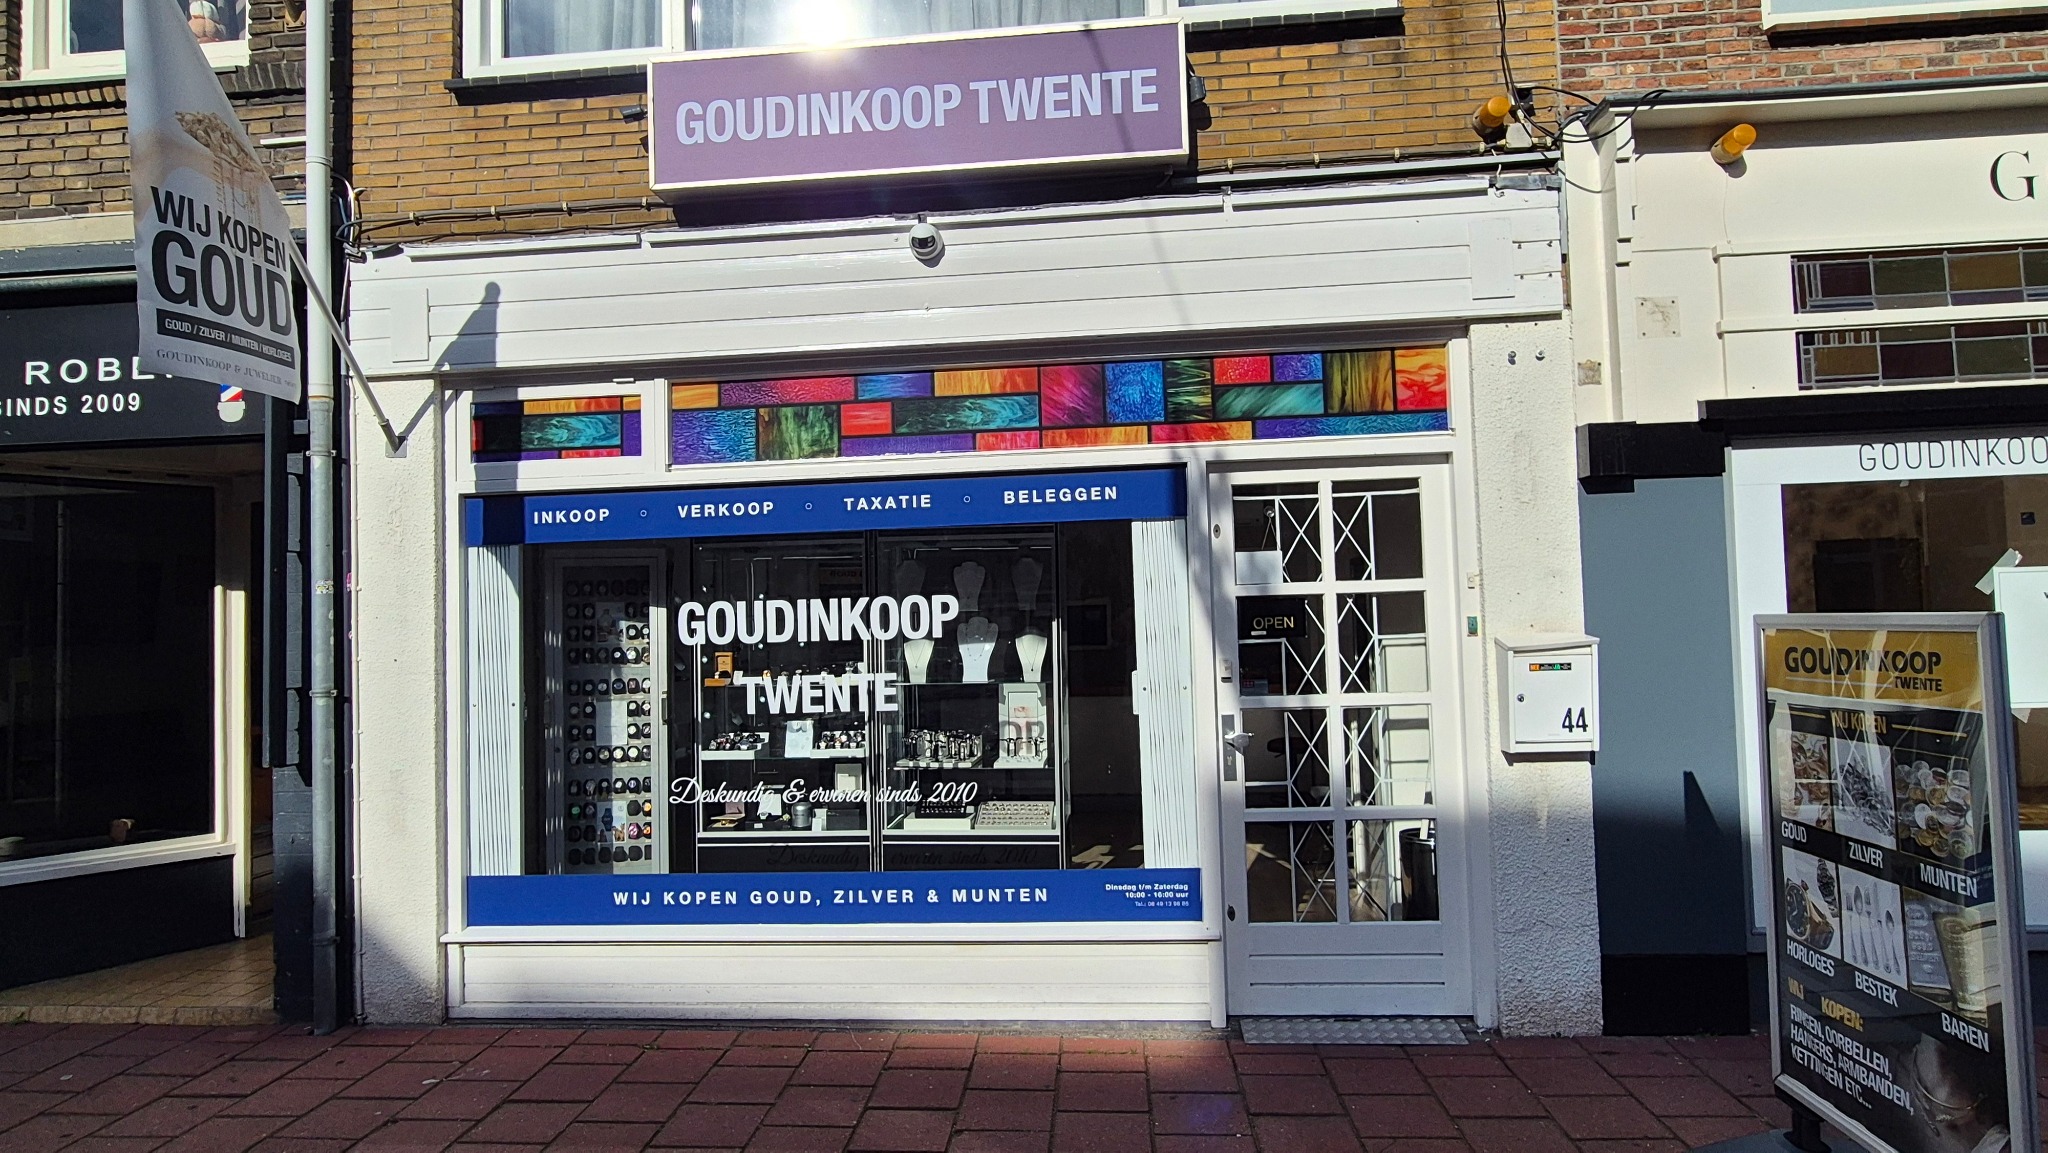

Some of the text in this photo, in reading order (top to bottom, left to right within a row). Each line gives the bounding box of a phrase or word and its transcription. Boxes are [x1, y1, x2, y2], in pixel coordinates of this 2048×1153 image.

[676, 68, 1159, 145] GOUDINKOOP TWENTE
[150, 185, 287, 272] WIJ KOPEN
[151, 229, 292, 337] GOUD
[164, 318, 192, 334] GOUD
[199, 325, 226, 342] ZILVER
[157, 349, 232, 371] GOUDINKOOP
[243, 367, 282, 386] JUWELIER
[0, 392, 141, 417] INDS 2009
[677, 501, 774, 519] VERKOOP
[843, 494, 931, 511] TAXATIE
[1003, 486, 1118, 505] BELEGGEN
[533, 508, 610, 525] INKOOP
[677, 594, 959, 646] GOUDINKOOP
[1253, 616, 1294, 629] OPEN
[741, 672, 898, 715] TWENTE
[1894, 675, 1943, 692] TWENTE
[1561, 707, 1588, 733] 44
[669, 777, 978, 810] Deskundig & ervaren sinds 2010
[1781, 820, 1807, 844] GOUD
[1848, 840, 1884, 869] ZILVER
[613, 888, 1048, 907] WIJ KOPEN GOUD, ZILVER & MUNTEN
[1138, 883, 1152, 891] t/m
[1153, 883, 1189, 891] Zaterdag
[1919, 862, 1979, 899] MUNTEN
[1786, 938, 1835, 978] HORLOGES
[1855, 970, 1899, 1008] BESTEK
[1821, 995, 1864, 1033] KOPEN:
[1790, 1003, 1892, 1082] RINGEN, OORBELLEN,
[1941, 1011, 1990, 1053] BAREN
[1790, 1041, 1843, 1091] KETTINGEN
[1790, 1023, 1915, 1117] HANGERS, ARMBANDEN,
